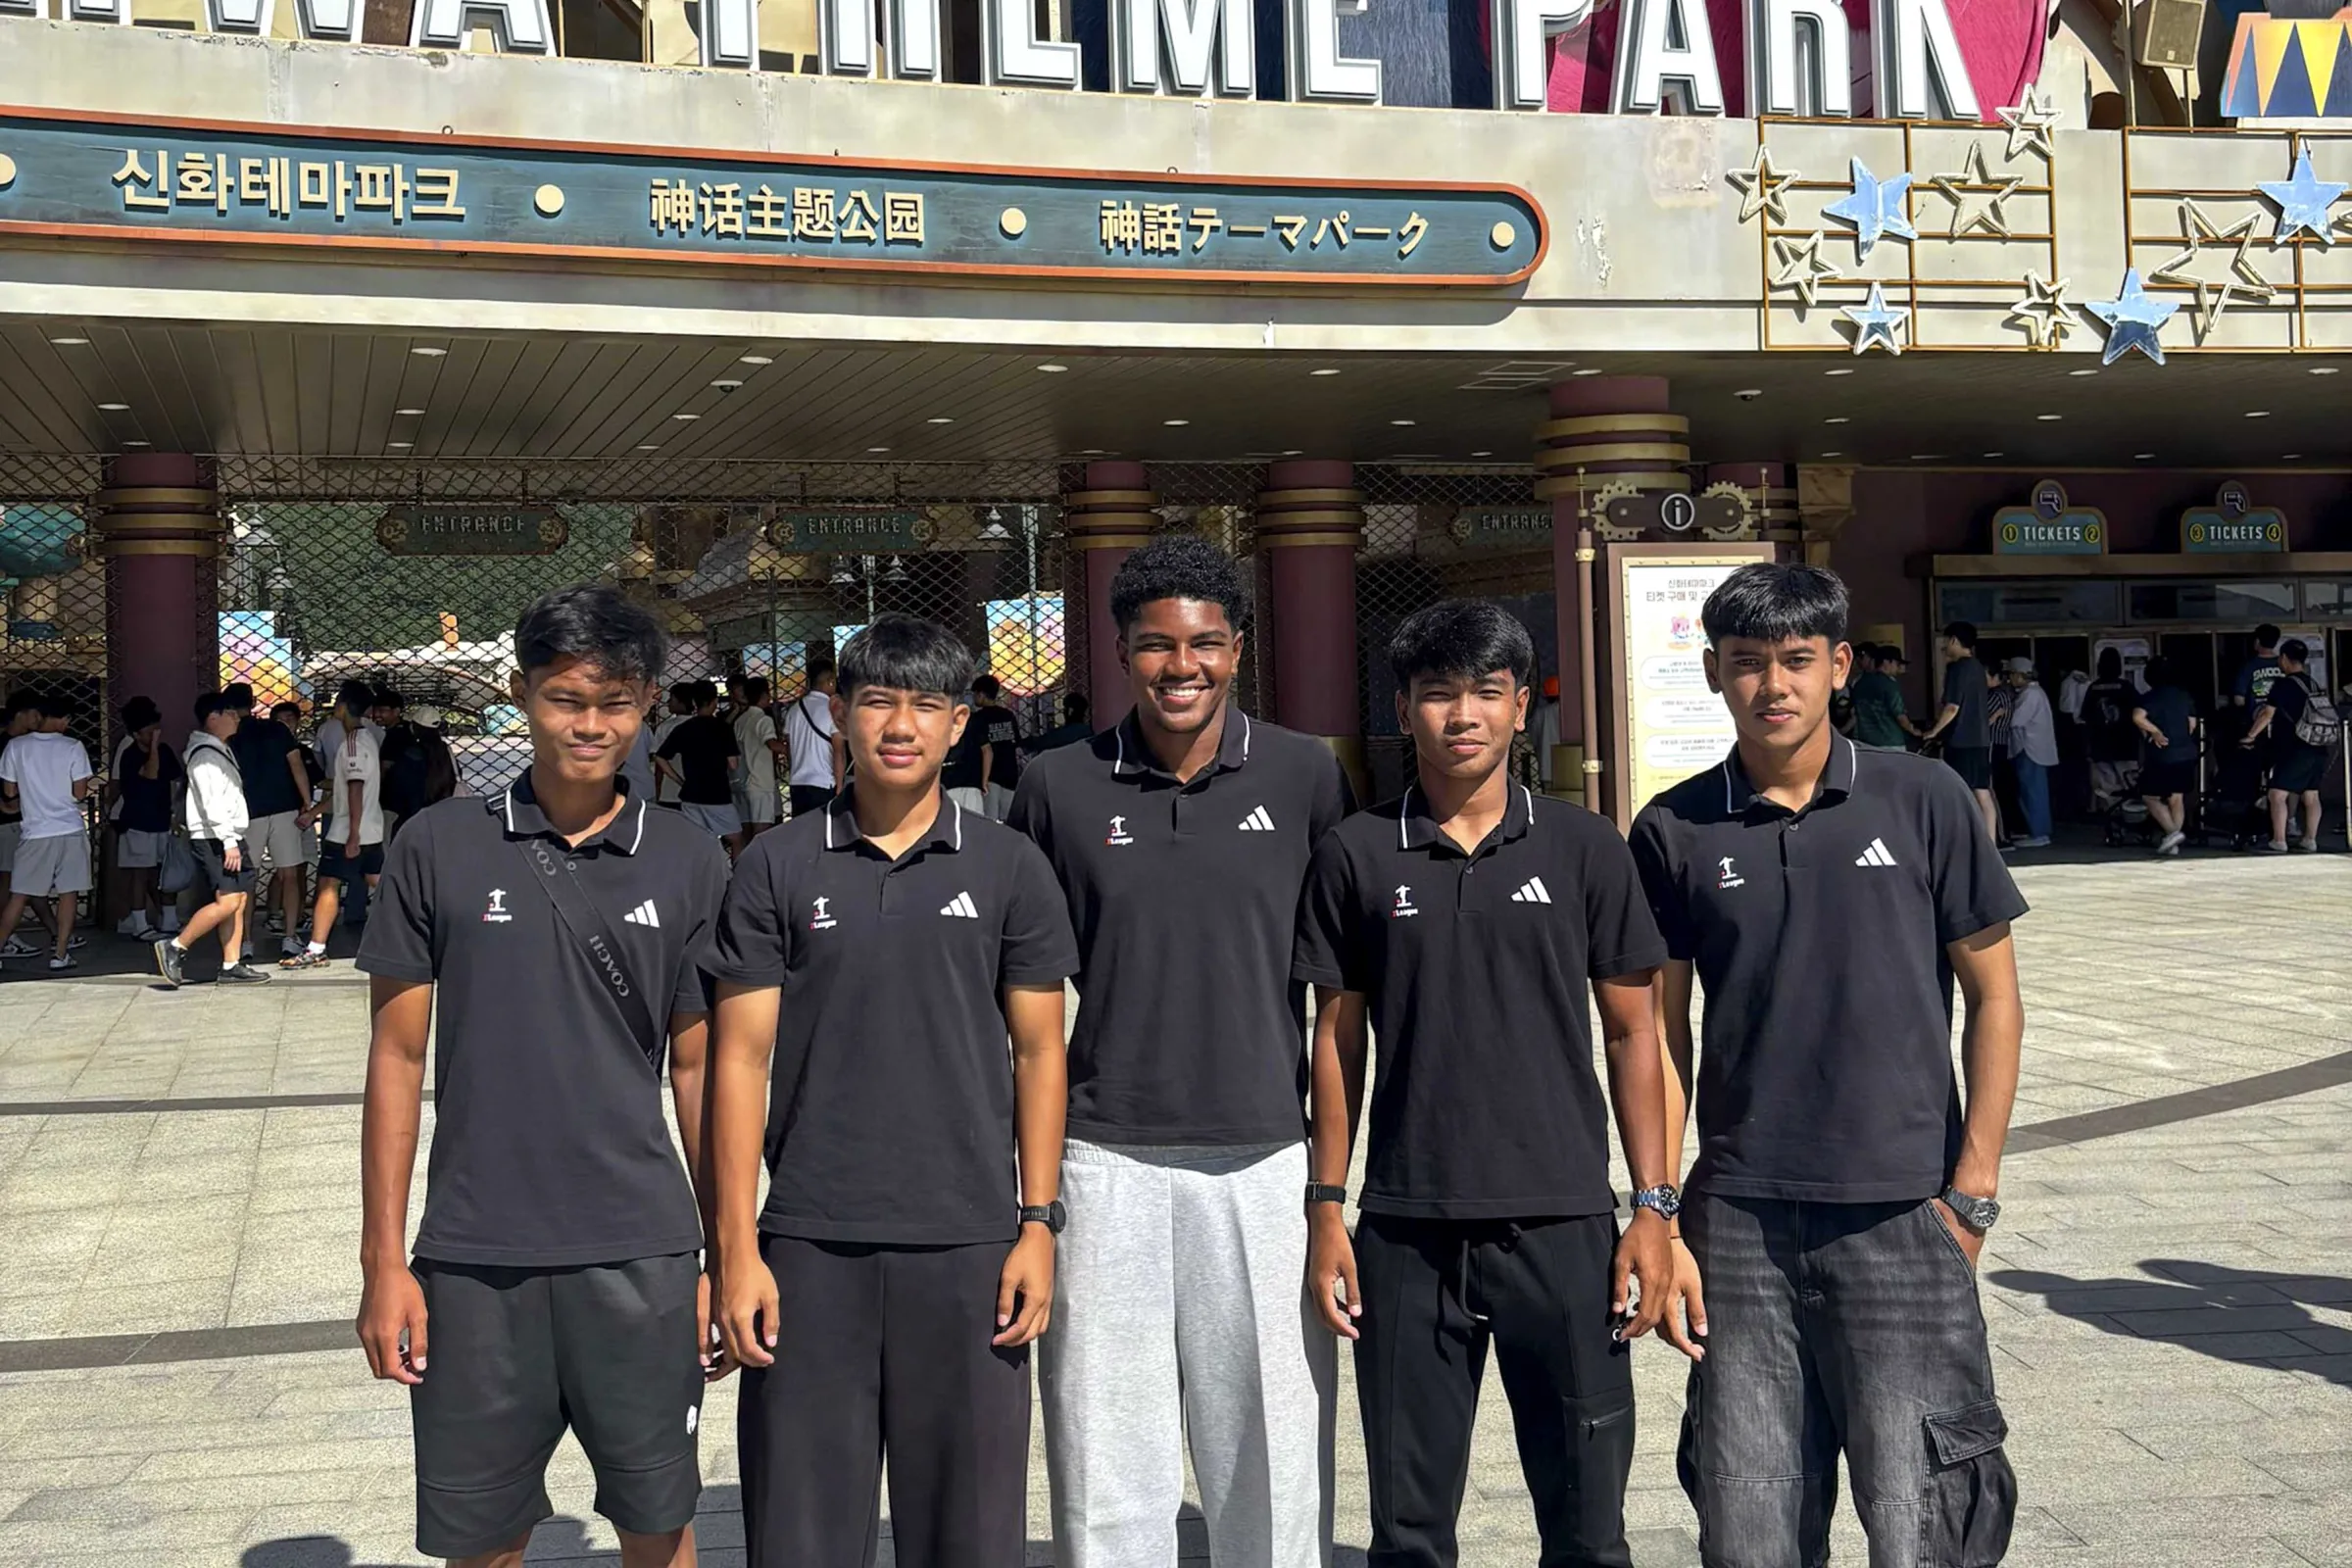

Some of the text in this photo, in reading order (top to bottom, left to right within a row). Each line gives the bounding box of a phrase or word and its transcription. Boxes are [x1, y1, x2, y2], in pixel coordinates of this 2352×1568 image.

[111, 148, 466, 220] 신화테마파크
[649, 177, 925, 244] 神话主题公园
[1100, 199, 1430, 257] 神話テーマパーク
[420, 514, 525, 534] ENTRANCE
[808, 516, 901, 535] ENTRANCE
[1482, 514, 1554, 530] ENTRANC
[2023, 526, 2081, 541] TICKETS
[2210, 525, 2263, 540] TICKETS
[530, 840, 557, 876] COA
[589, 934, 630, 998] COACH
